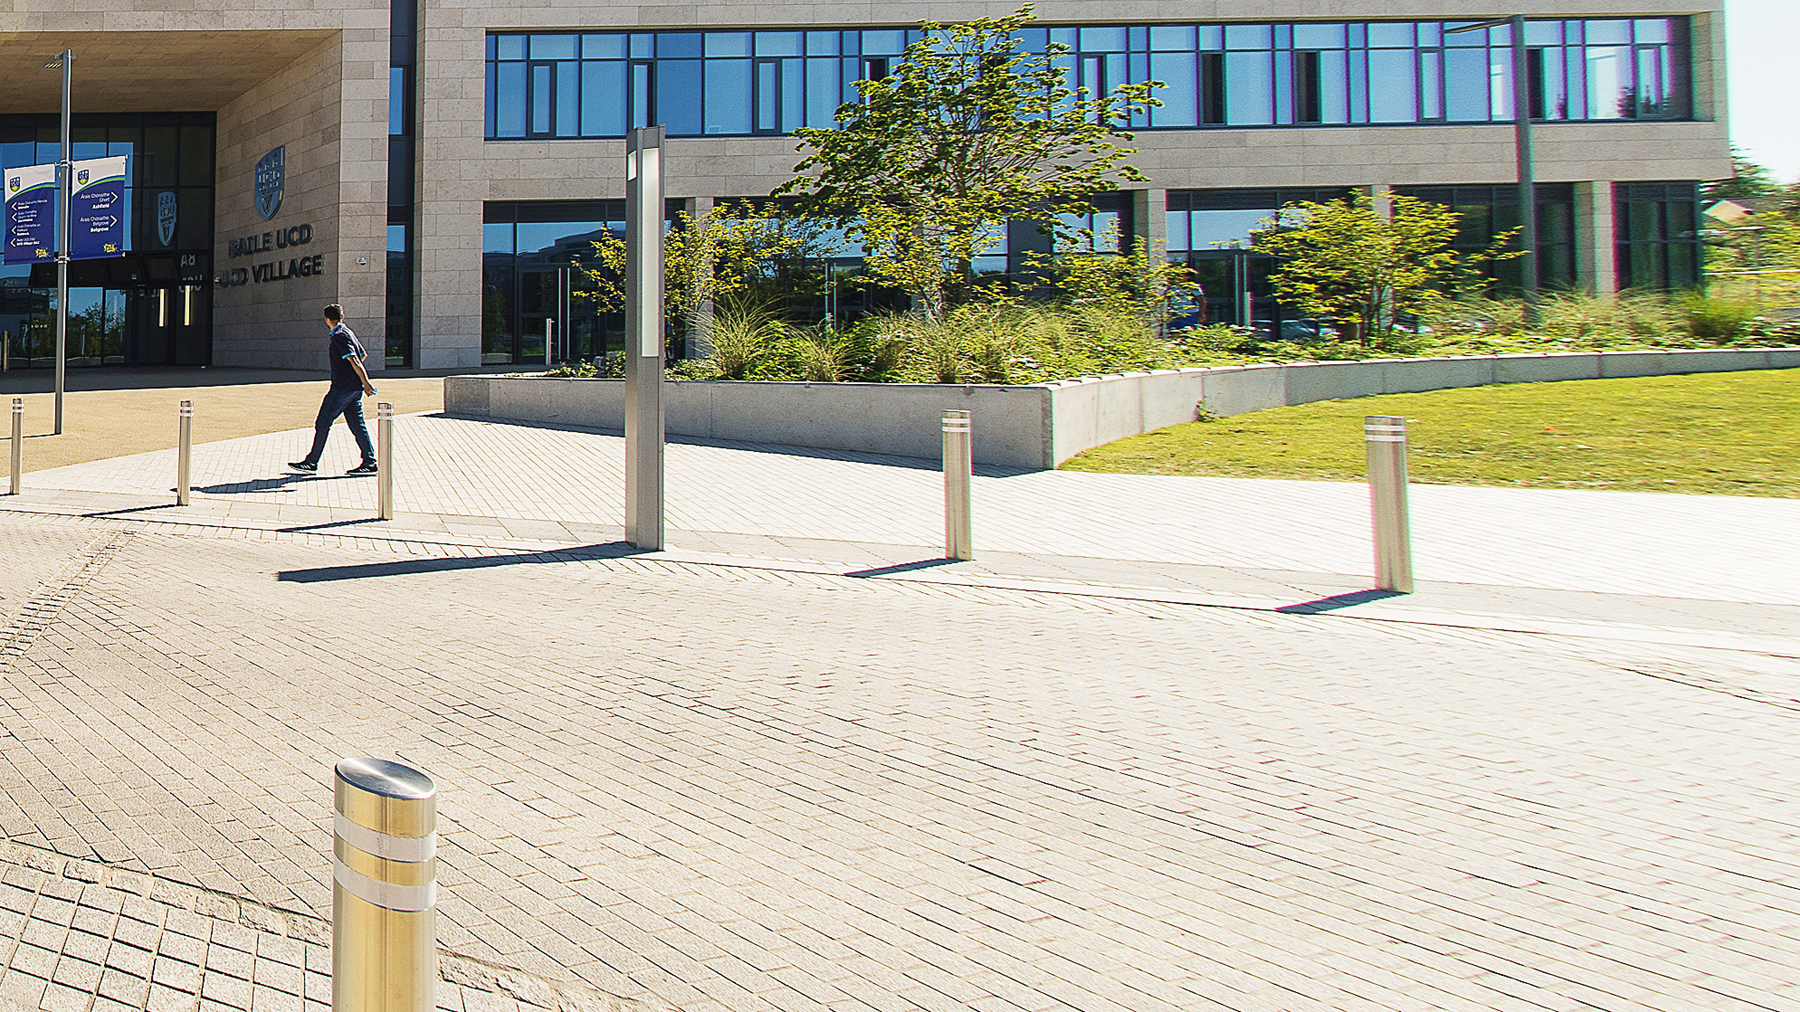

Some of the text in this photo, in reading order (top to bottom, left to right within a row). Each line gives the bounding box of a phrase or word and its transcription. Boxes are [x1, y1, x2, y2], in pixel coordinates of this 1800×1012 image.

[228, 224, 313, 258] BAILE UCD
[218, 268, 249, 288] UCD
[252, 254, 325, 284] VILLAGE
